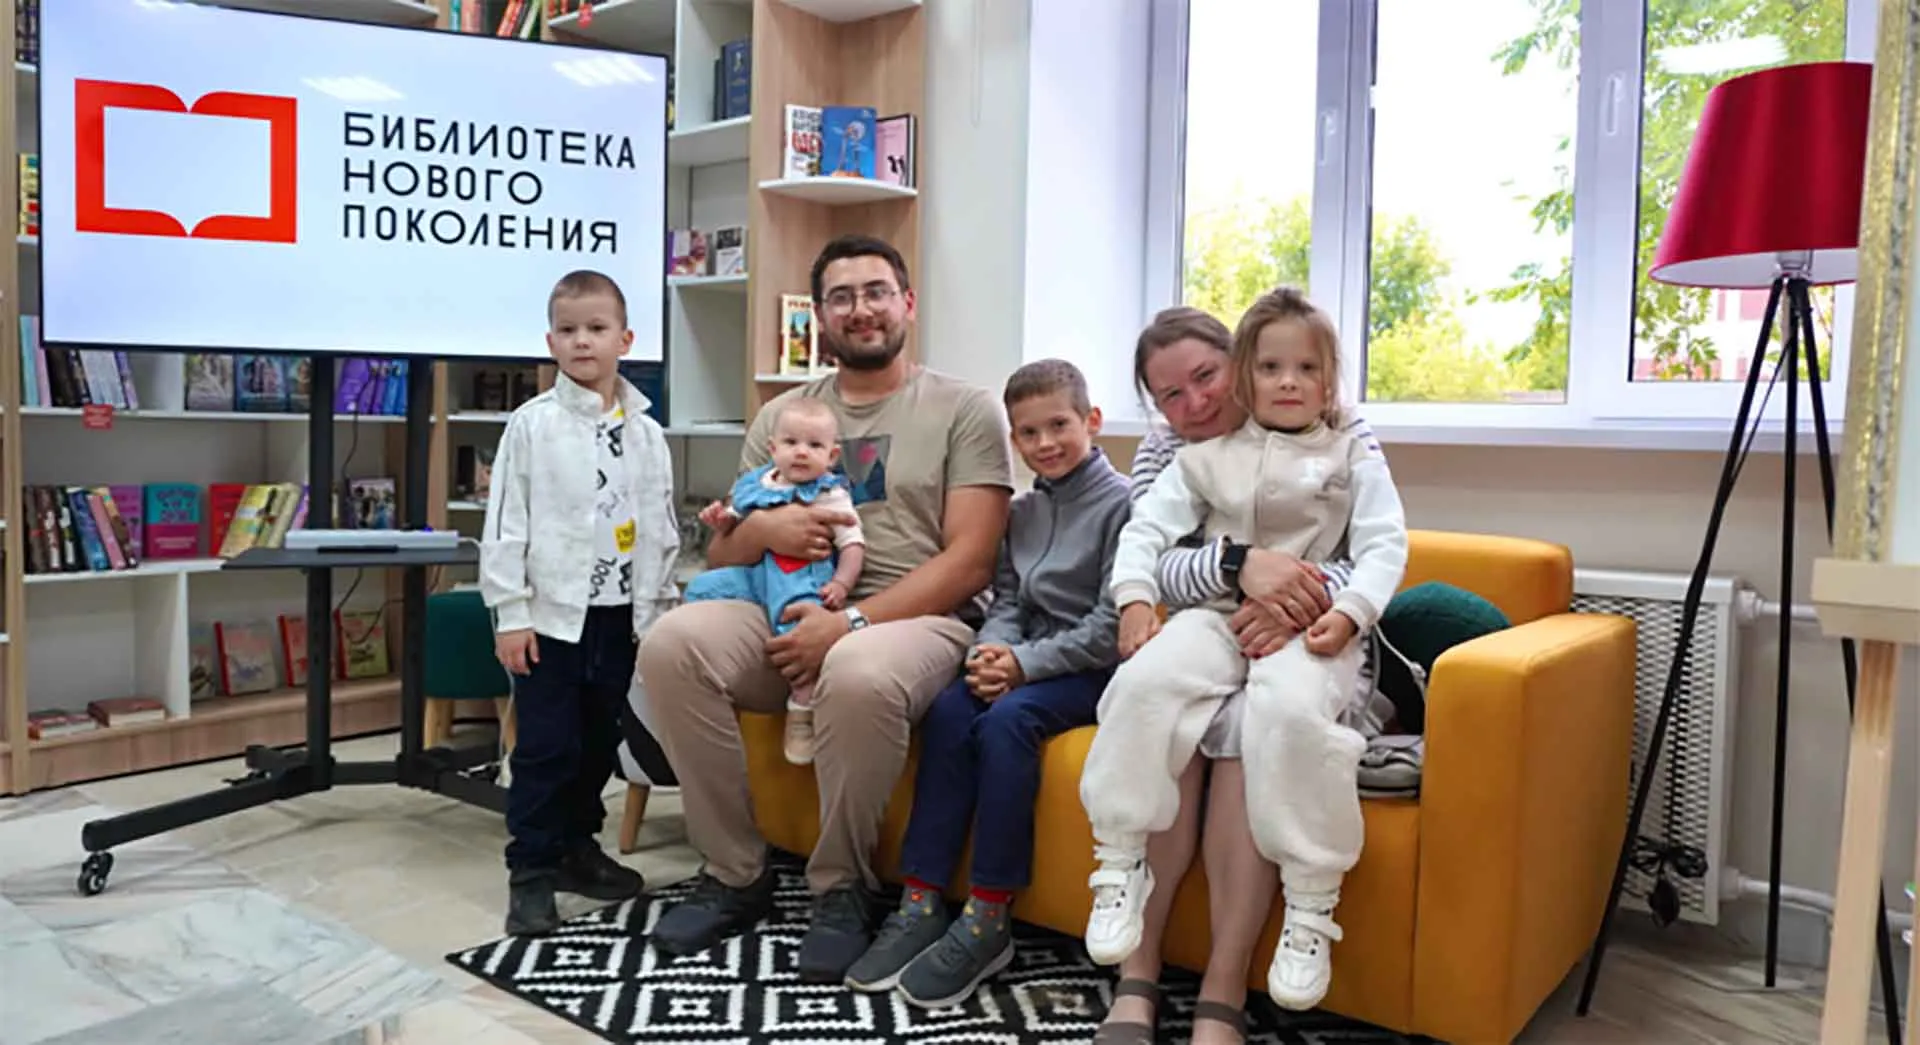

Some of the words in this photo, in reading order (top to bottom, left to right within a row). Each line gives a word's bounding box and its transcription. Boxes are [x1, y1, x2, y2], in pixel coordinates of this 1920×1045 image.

[344, 111, 636, 169] БИБЛИОТЕКА
[343, 157, 543, 206] НОВОГО
[343, 204, 617, 254] ПОКОЛЕНИЯ
